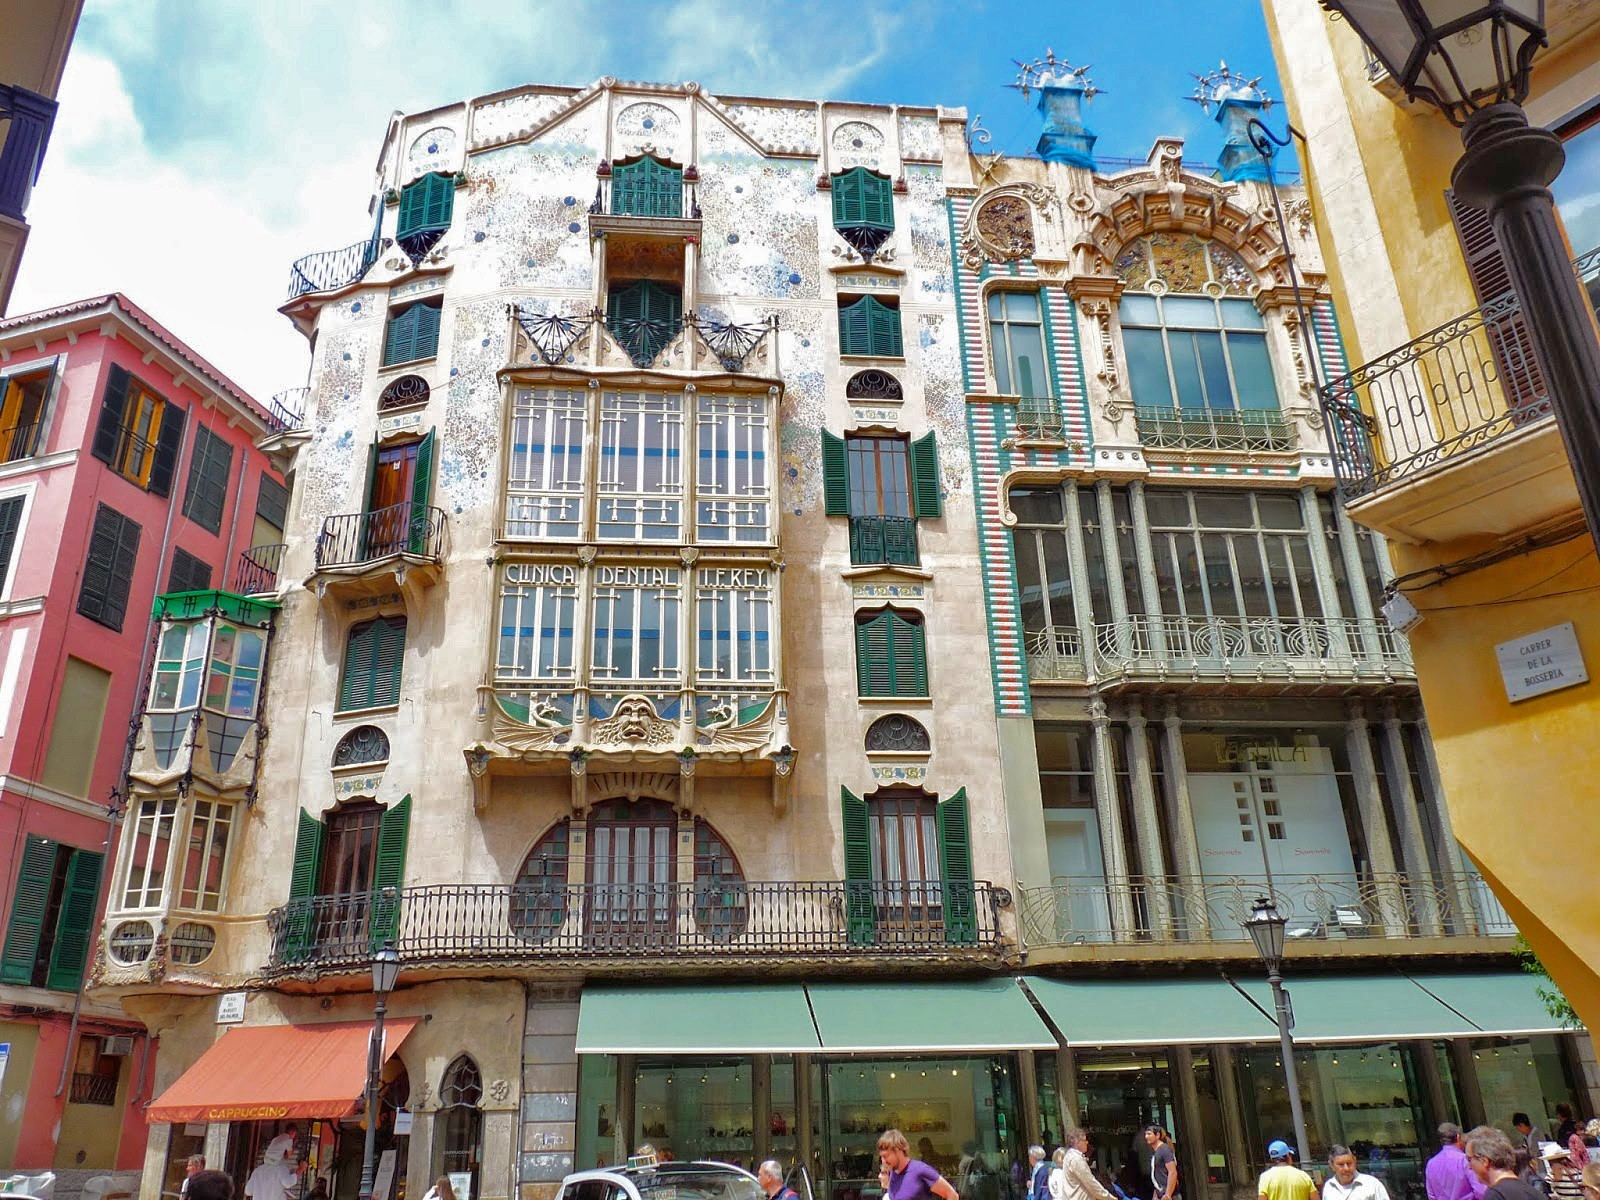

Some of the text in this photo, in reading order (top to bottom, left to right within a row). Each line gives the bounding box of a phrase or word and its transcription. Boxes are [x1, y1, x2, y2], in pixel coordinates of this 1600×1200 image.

[506, 564, 575, 584] CLINICA
[601, 565, 679, 586] DENTAL
[1520, 639, 1552, 656] CARRER
[1527, 656, 1553, 670] DE LA
[1524, 669, 1564, 687] BOSSERIA
[208, 1106, 288, 1119] CAPPUCCINO
